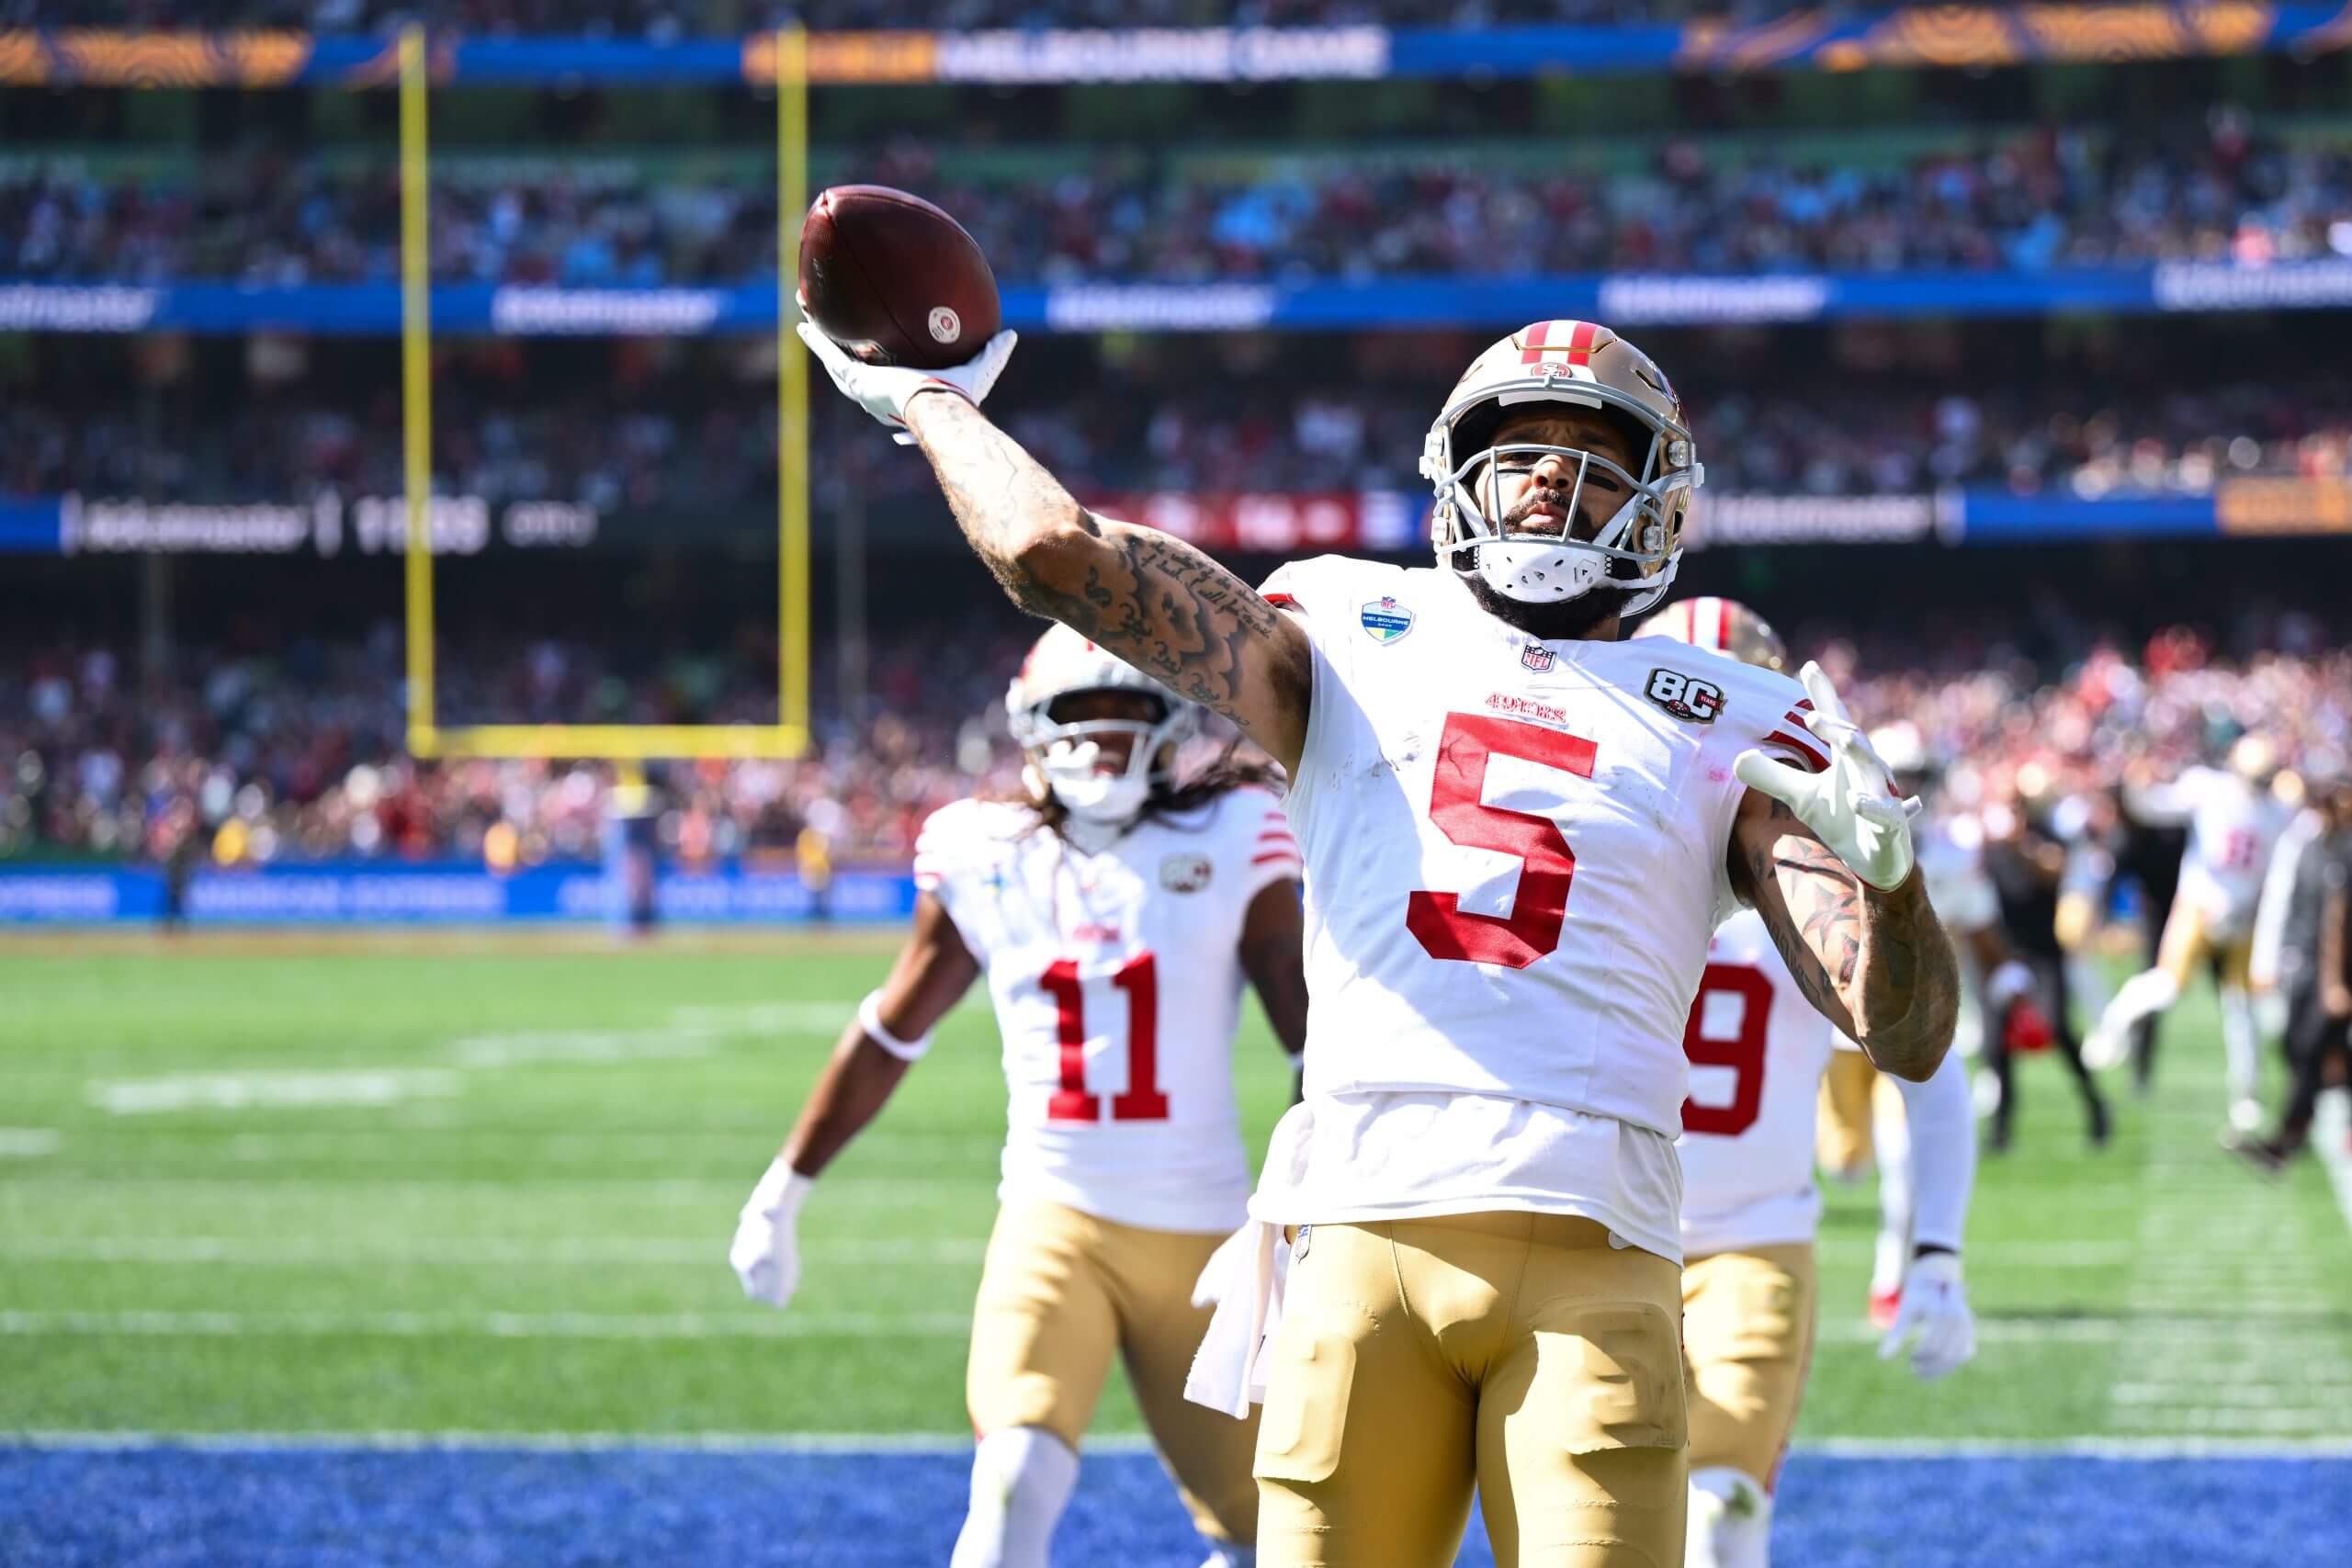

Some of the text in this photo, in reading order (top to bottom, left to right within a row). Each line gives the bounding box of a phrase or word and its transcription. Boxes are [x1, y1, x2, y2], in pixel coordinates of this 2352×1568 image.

[1524, 653, 1548, 668] NFL
[1405, 711, 1599, 970] 5
[1038, 951, 1170, 1123] 11
